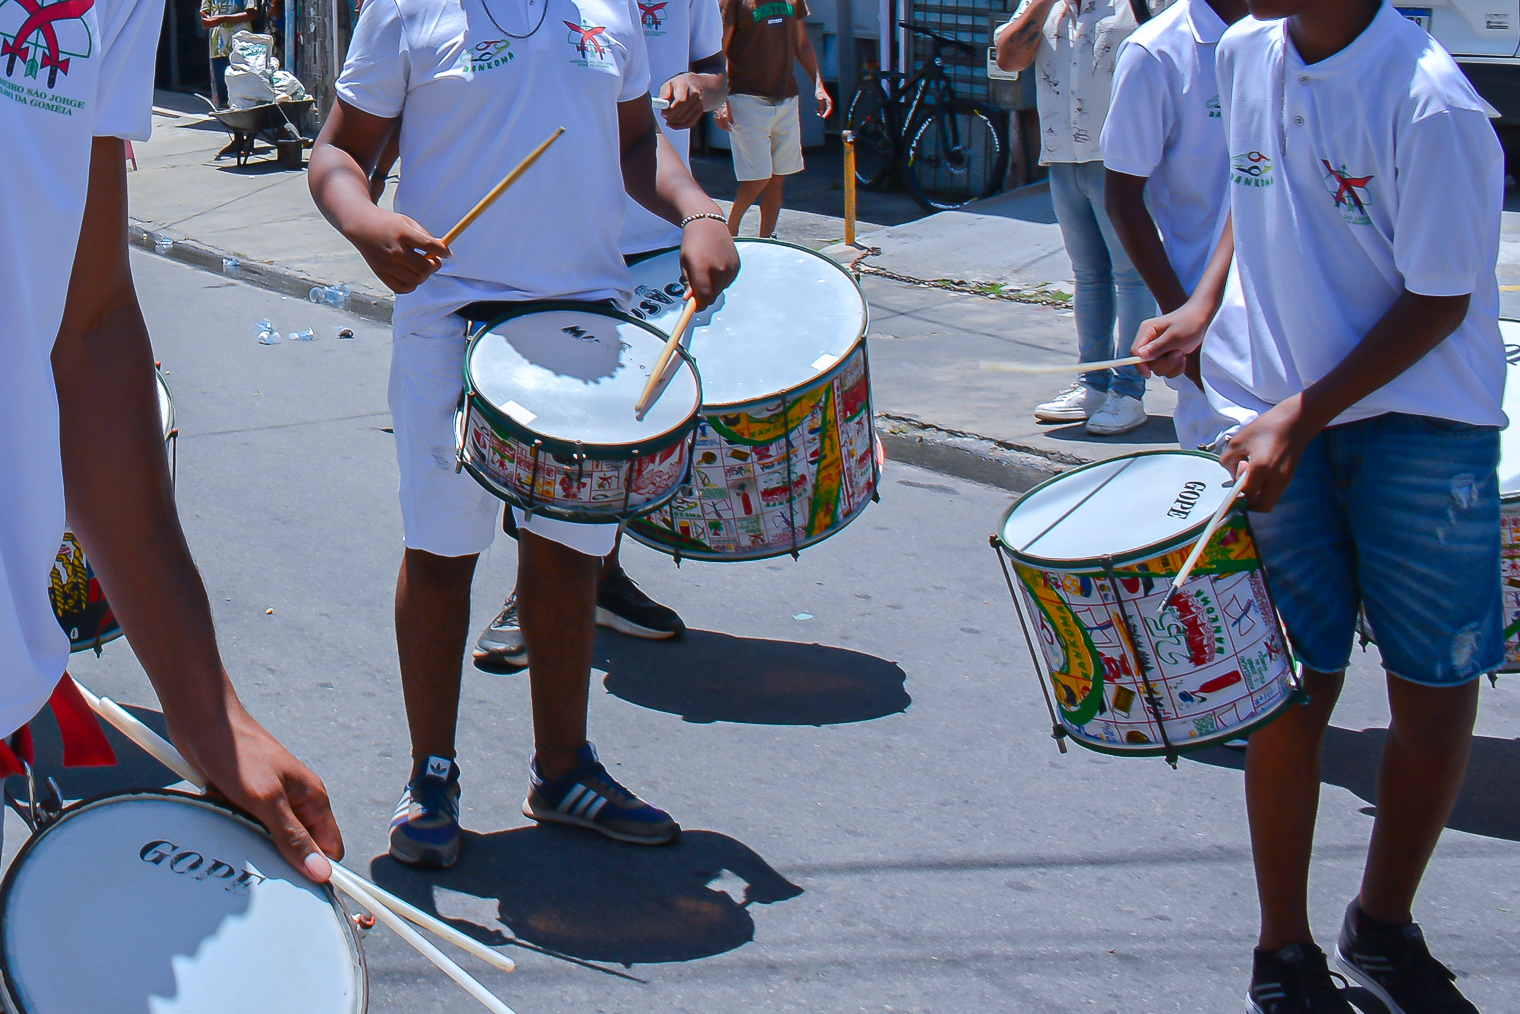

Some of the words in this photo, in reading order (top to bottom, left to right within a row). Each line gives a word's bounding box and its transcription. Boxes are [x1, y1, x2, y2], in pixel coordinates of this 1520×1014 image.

[753, 2, 794, 23] BOSTON
[463, 51, 515, 72] BANKOMA
[15, 95, 27, 104] DA
[49, 94, 85, 109] JORGE
[1167, 480, 1207, 520] GOPE
[138, 839, 267, 894] GOPE
